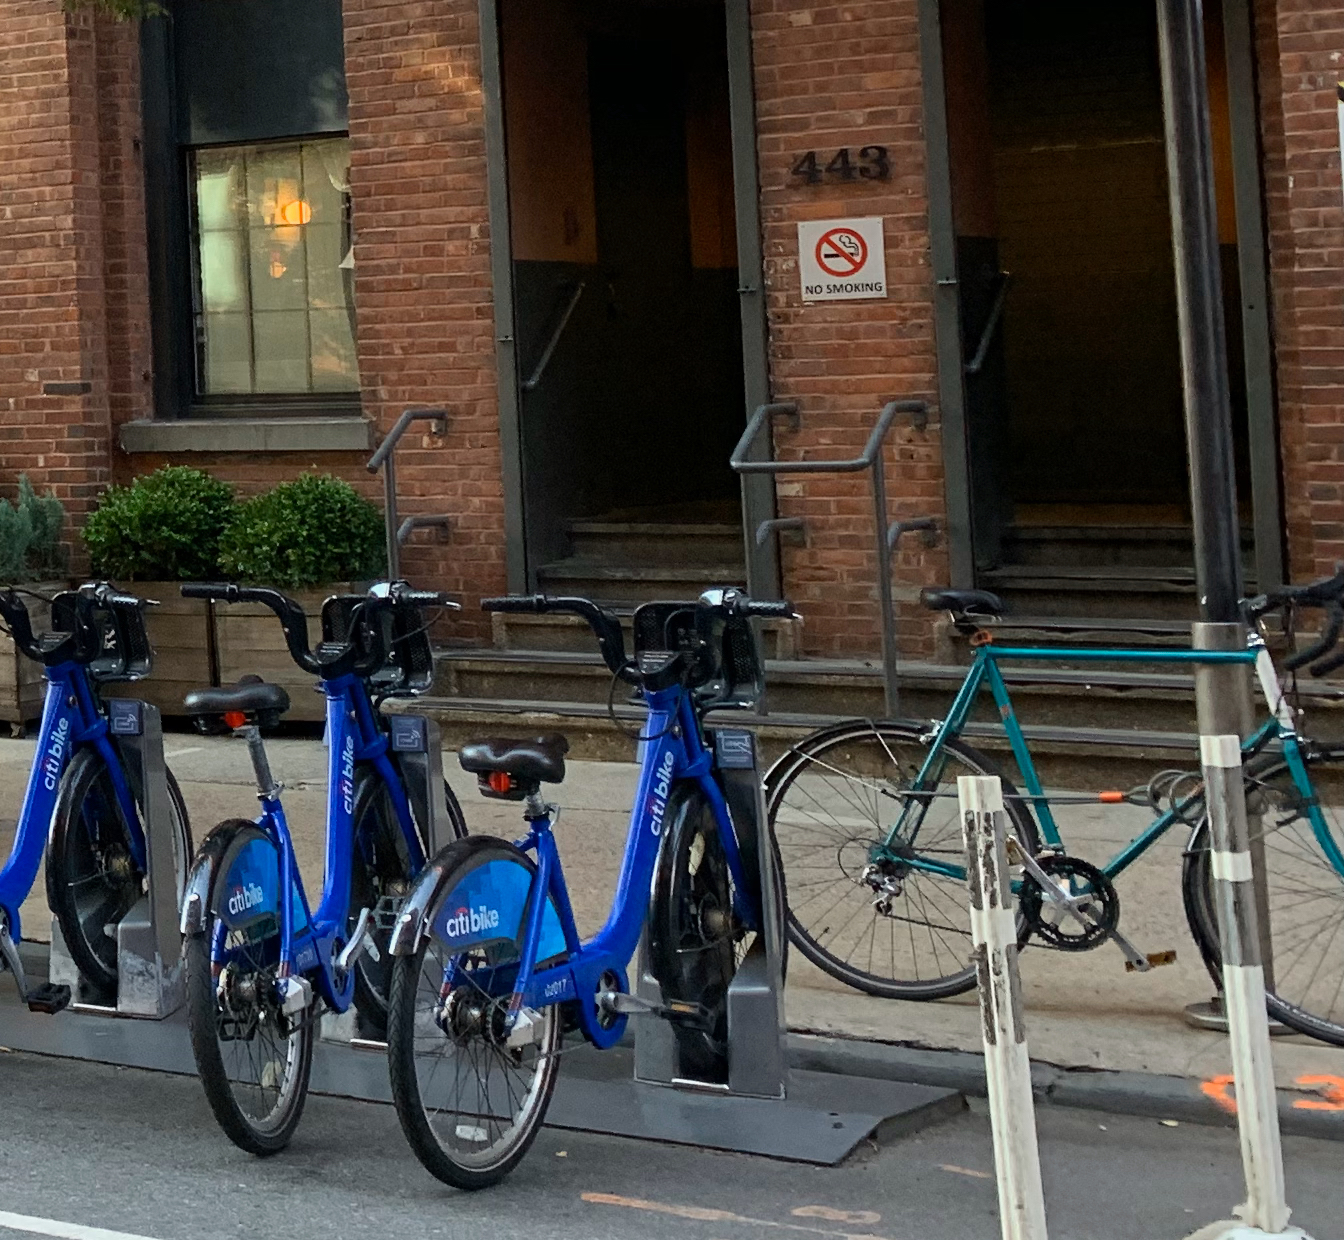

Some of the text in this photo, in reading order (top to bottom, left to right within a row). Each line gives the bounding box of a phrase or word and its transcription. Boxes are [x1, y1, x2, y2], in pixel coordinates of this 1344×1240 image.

[790, 145, 891, 184] 443
[804, 282, 883, 295] NO SMOKING
[45, 717, 69, 791] citi bike
[342, 735, 354, 780] bike
[651, 751, 674, 836] citi bike
[228, 882, 264, 915] citi bike
[446, 905, 500, 938] citi bike
